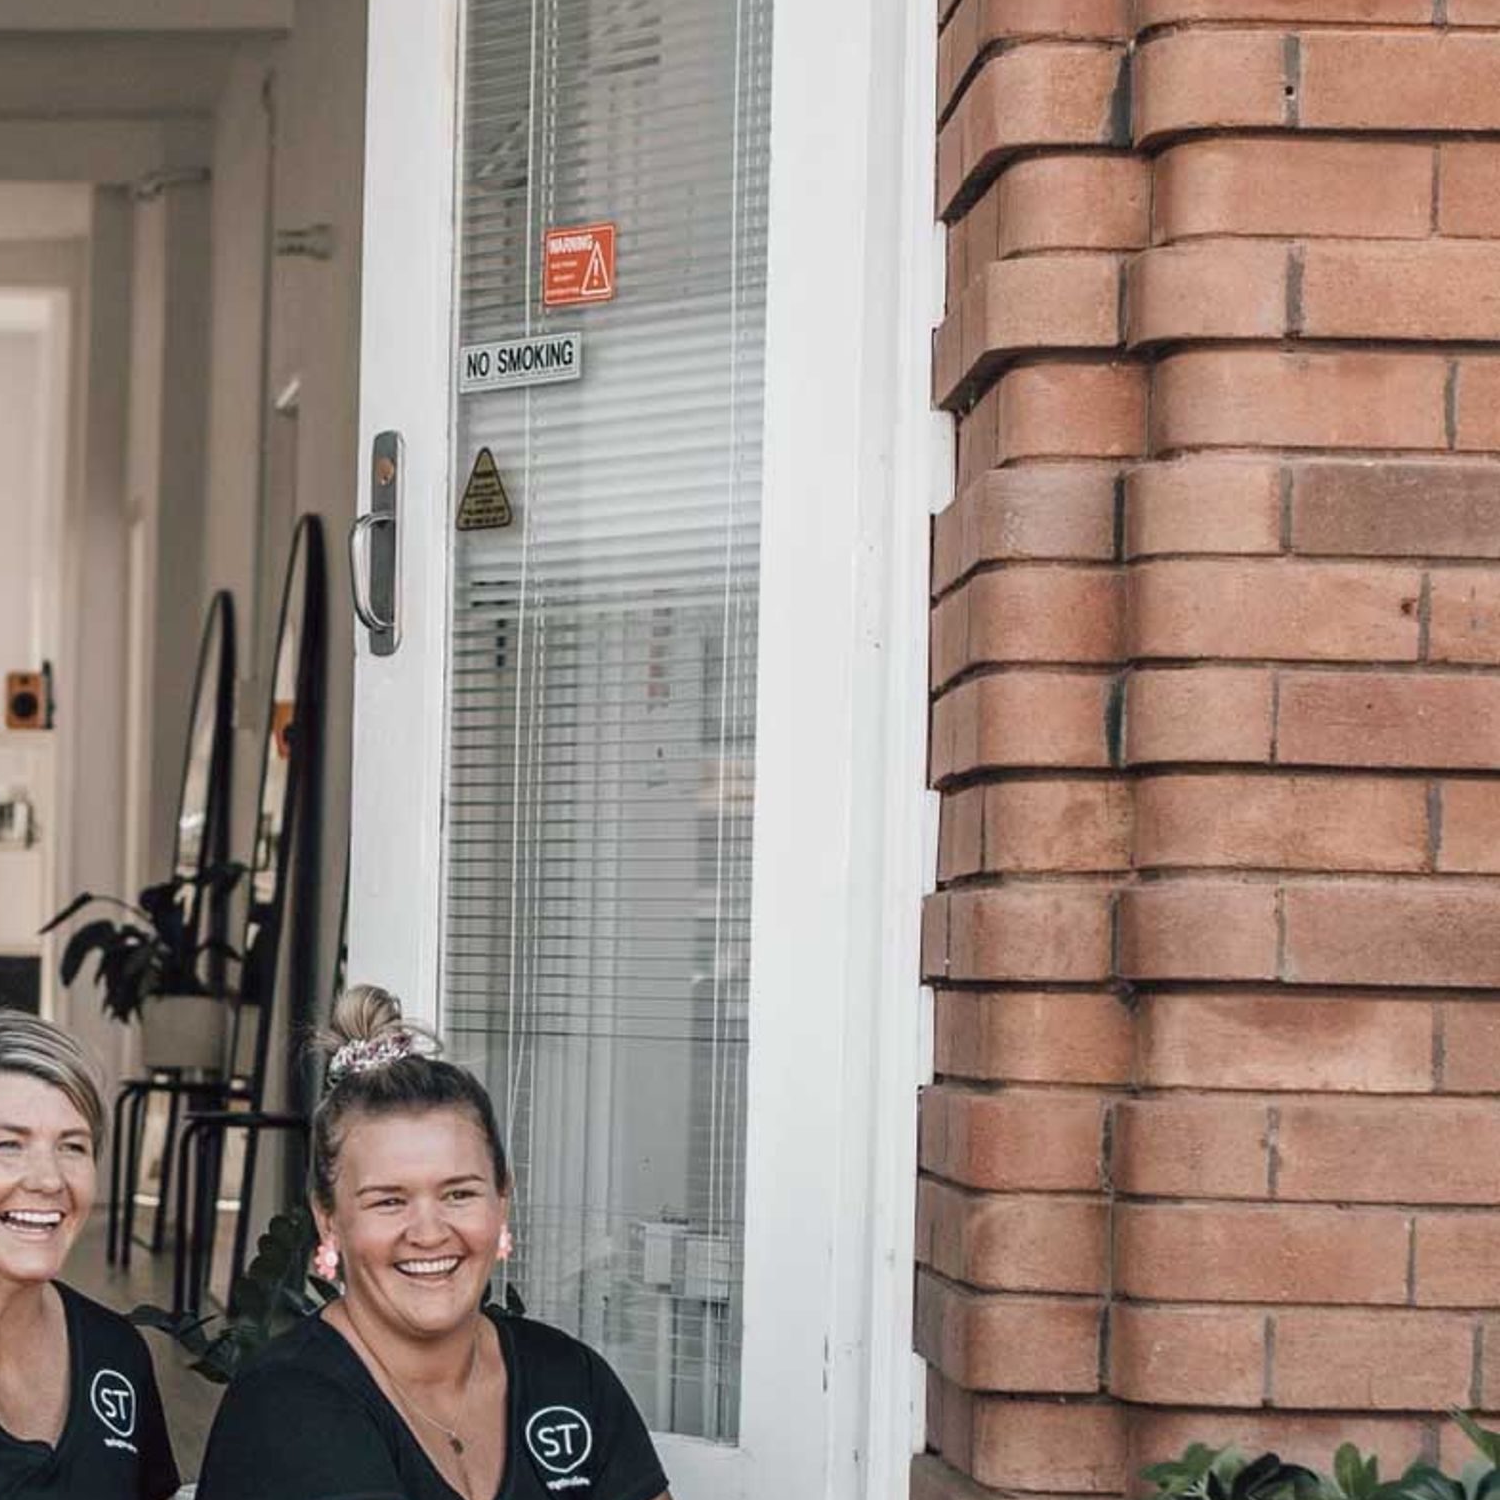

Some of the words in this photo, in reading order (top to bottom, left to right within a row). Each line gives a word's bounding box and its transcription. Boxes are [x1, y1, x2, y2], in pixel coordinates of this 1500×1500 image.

[467, 352, 490, 378] NO
[498, 340, 573, 373] SMOKING
[101, 1388, 129, 1420] ST
[537, 1423, 579, 1457] ST
